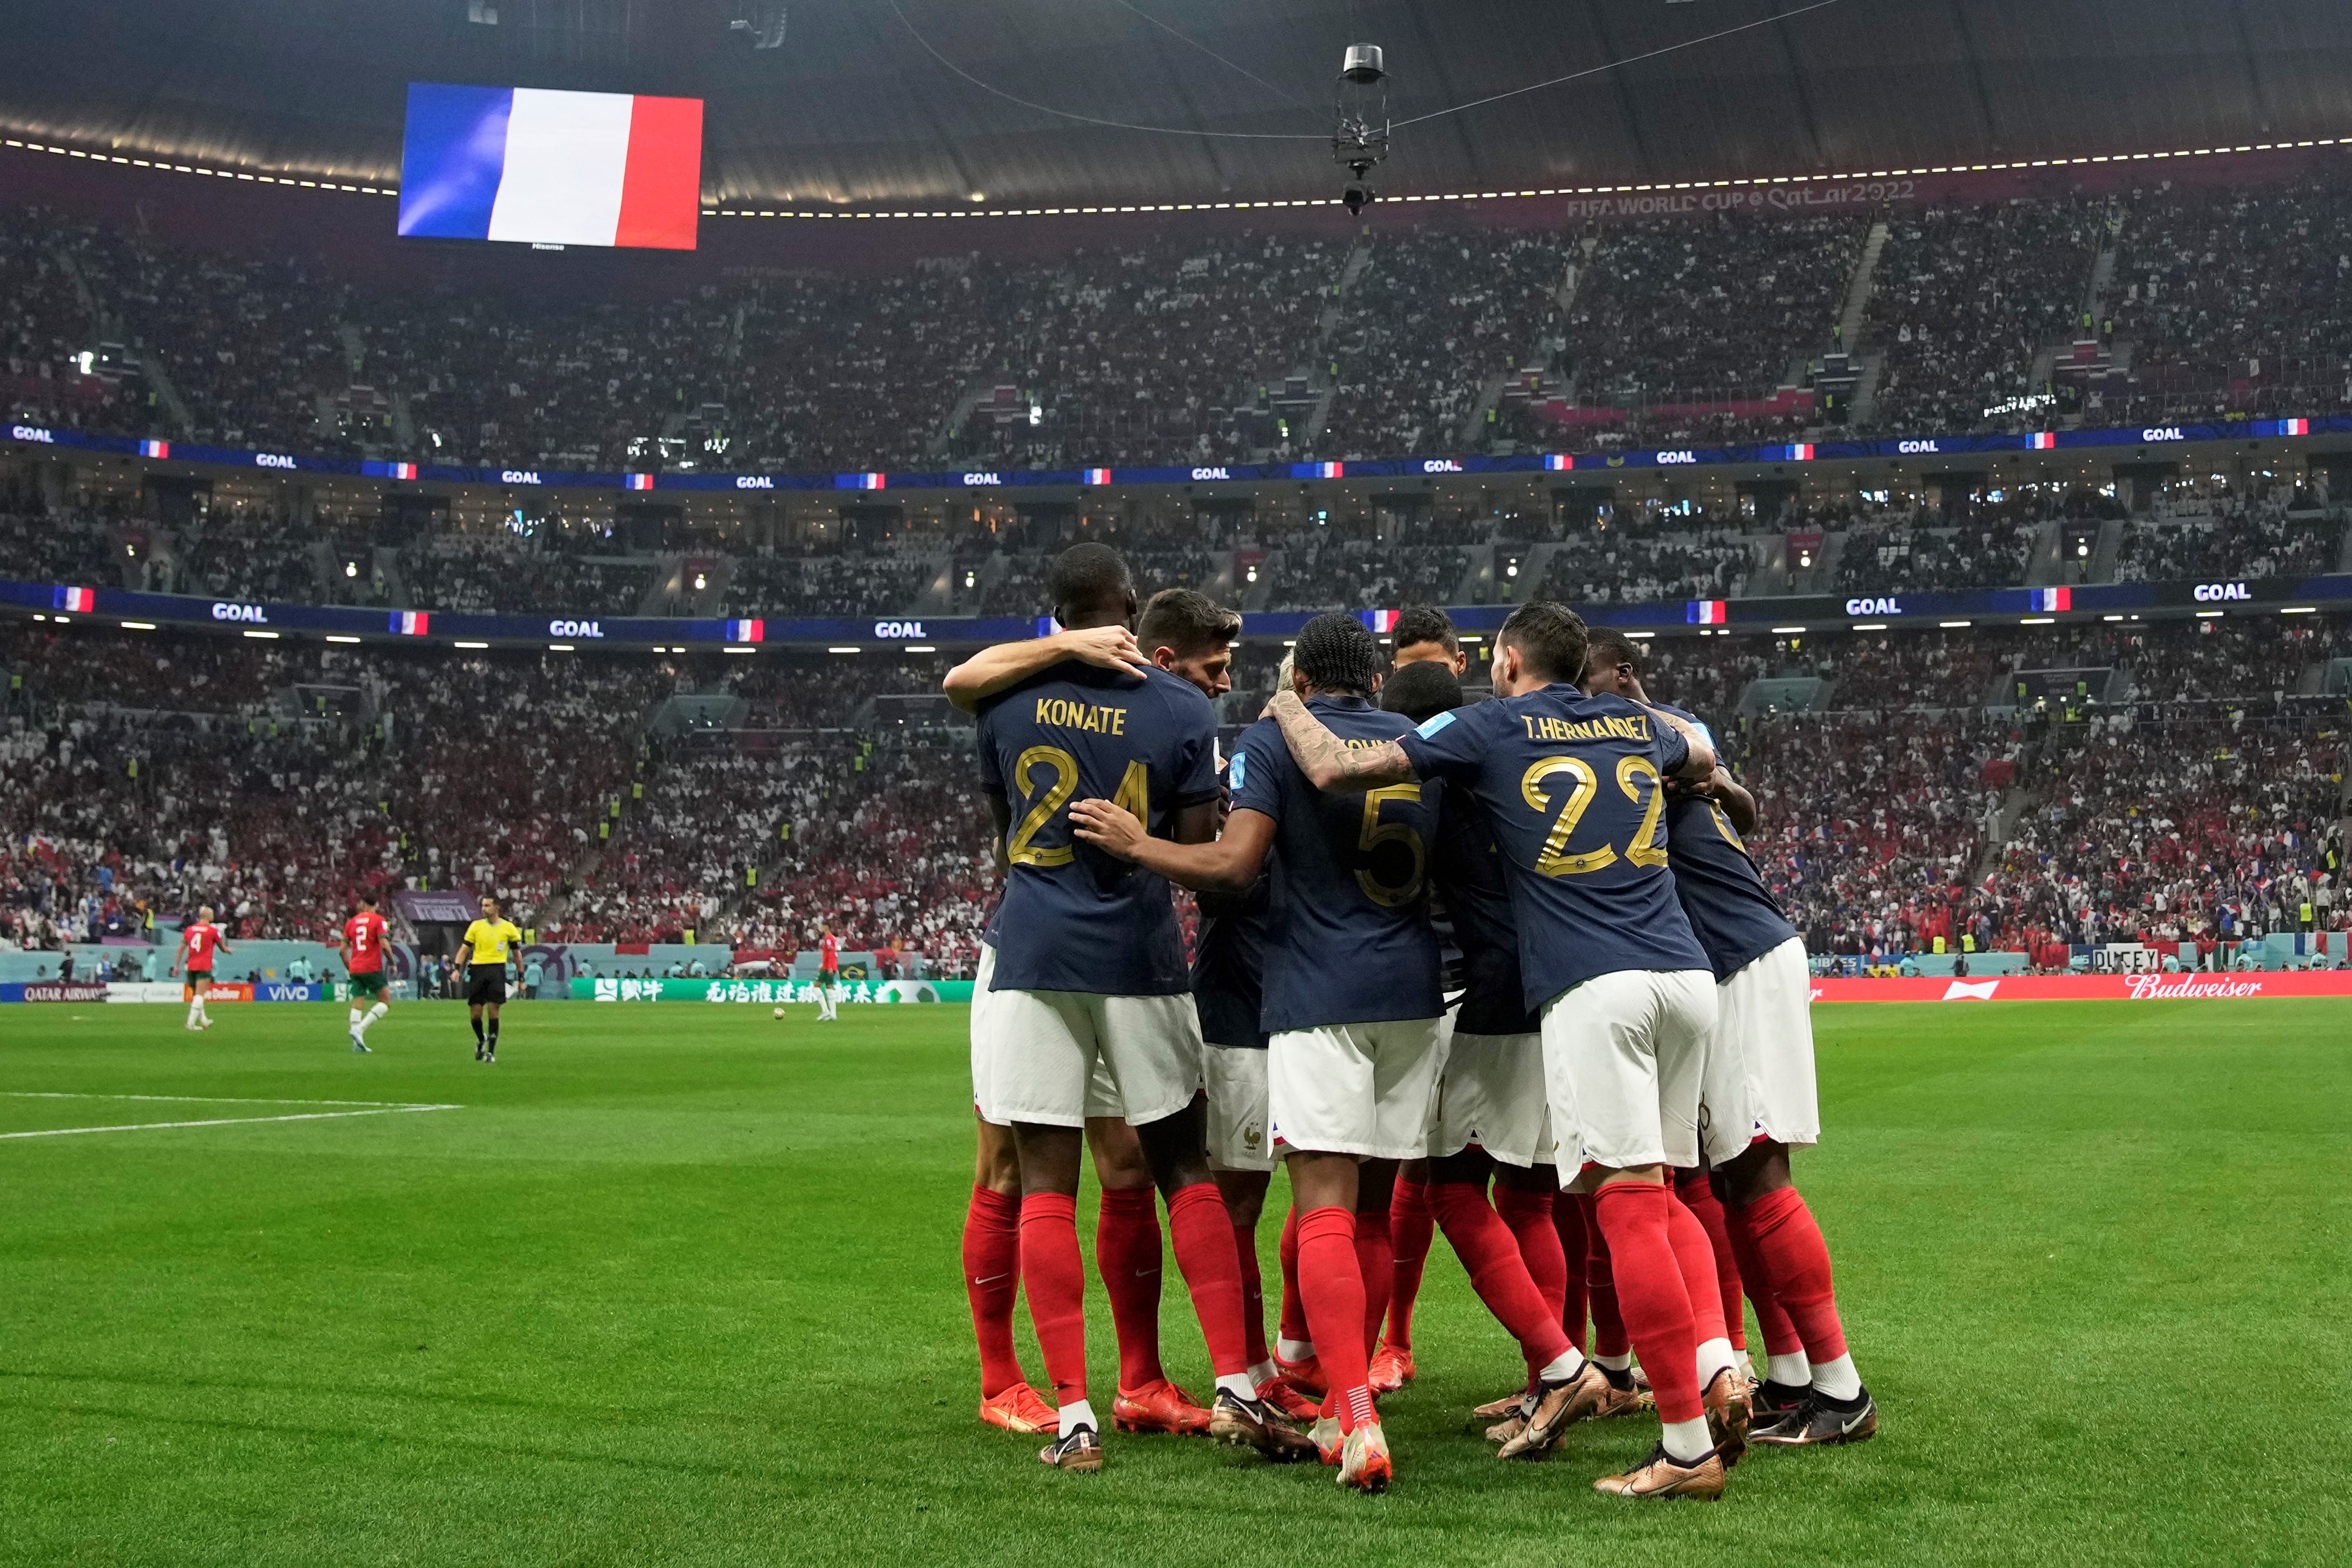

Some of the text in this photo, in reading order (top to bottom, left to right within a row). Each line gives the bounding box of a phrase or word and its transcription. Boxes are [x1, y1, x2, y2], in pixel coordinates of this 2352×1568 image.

[1568, 198, 1615, 217] FIFA
[1617, 195, 1697, 215] WORLD
[1701, 191, 1744, 210] CUP
[13, 426, 53, 443] GOAL
[2143, 427, 2184, 442] GOAL
[1899, 440, 1939, 453] GOAL
[256, 453, 297, 469] GOAL
[1424, 459, 1462, 472] GOAL
[1657, 451, 1696, 464] GOAL
[502, 471, 542, 484] GOAL
[964, 473, 1002, 485] GOAL
[1192, 467, 1230, 480] GOAL
[736, 476, 774, 489] GOAL
[2193, 583, 2251, 601] GOAL
[212, 602, 268, 623] GOAL
[1846, 597, 1901, 615] GOAL
[549, 620, 604, 637] GOAL
[874, 622, 927, 638] GOAL
[1036, 698, 1127, 735] KONATE
[1521, 715, 1651, 741] T.HERNANDEZ
[1521, 755, 1669, 878] 22
[1354, 783, 1425, 907] 5
[189, 932, 202, 953] 4
[355, 926, 367, 951] 2
[24, 986, 62, 1002] QATAR
[620, 978, 664, 1003] 蒙牛
[2124, 973, 2262, 1000] Budweiser
